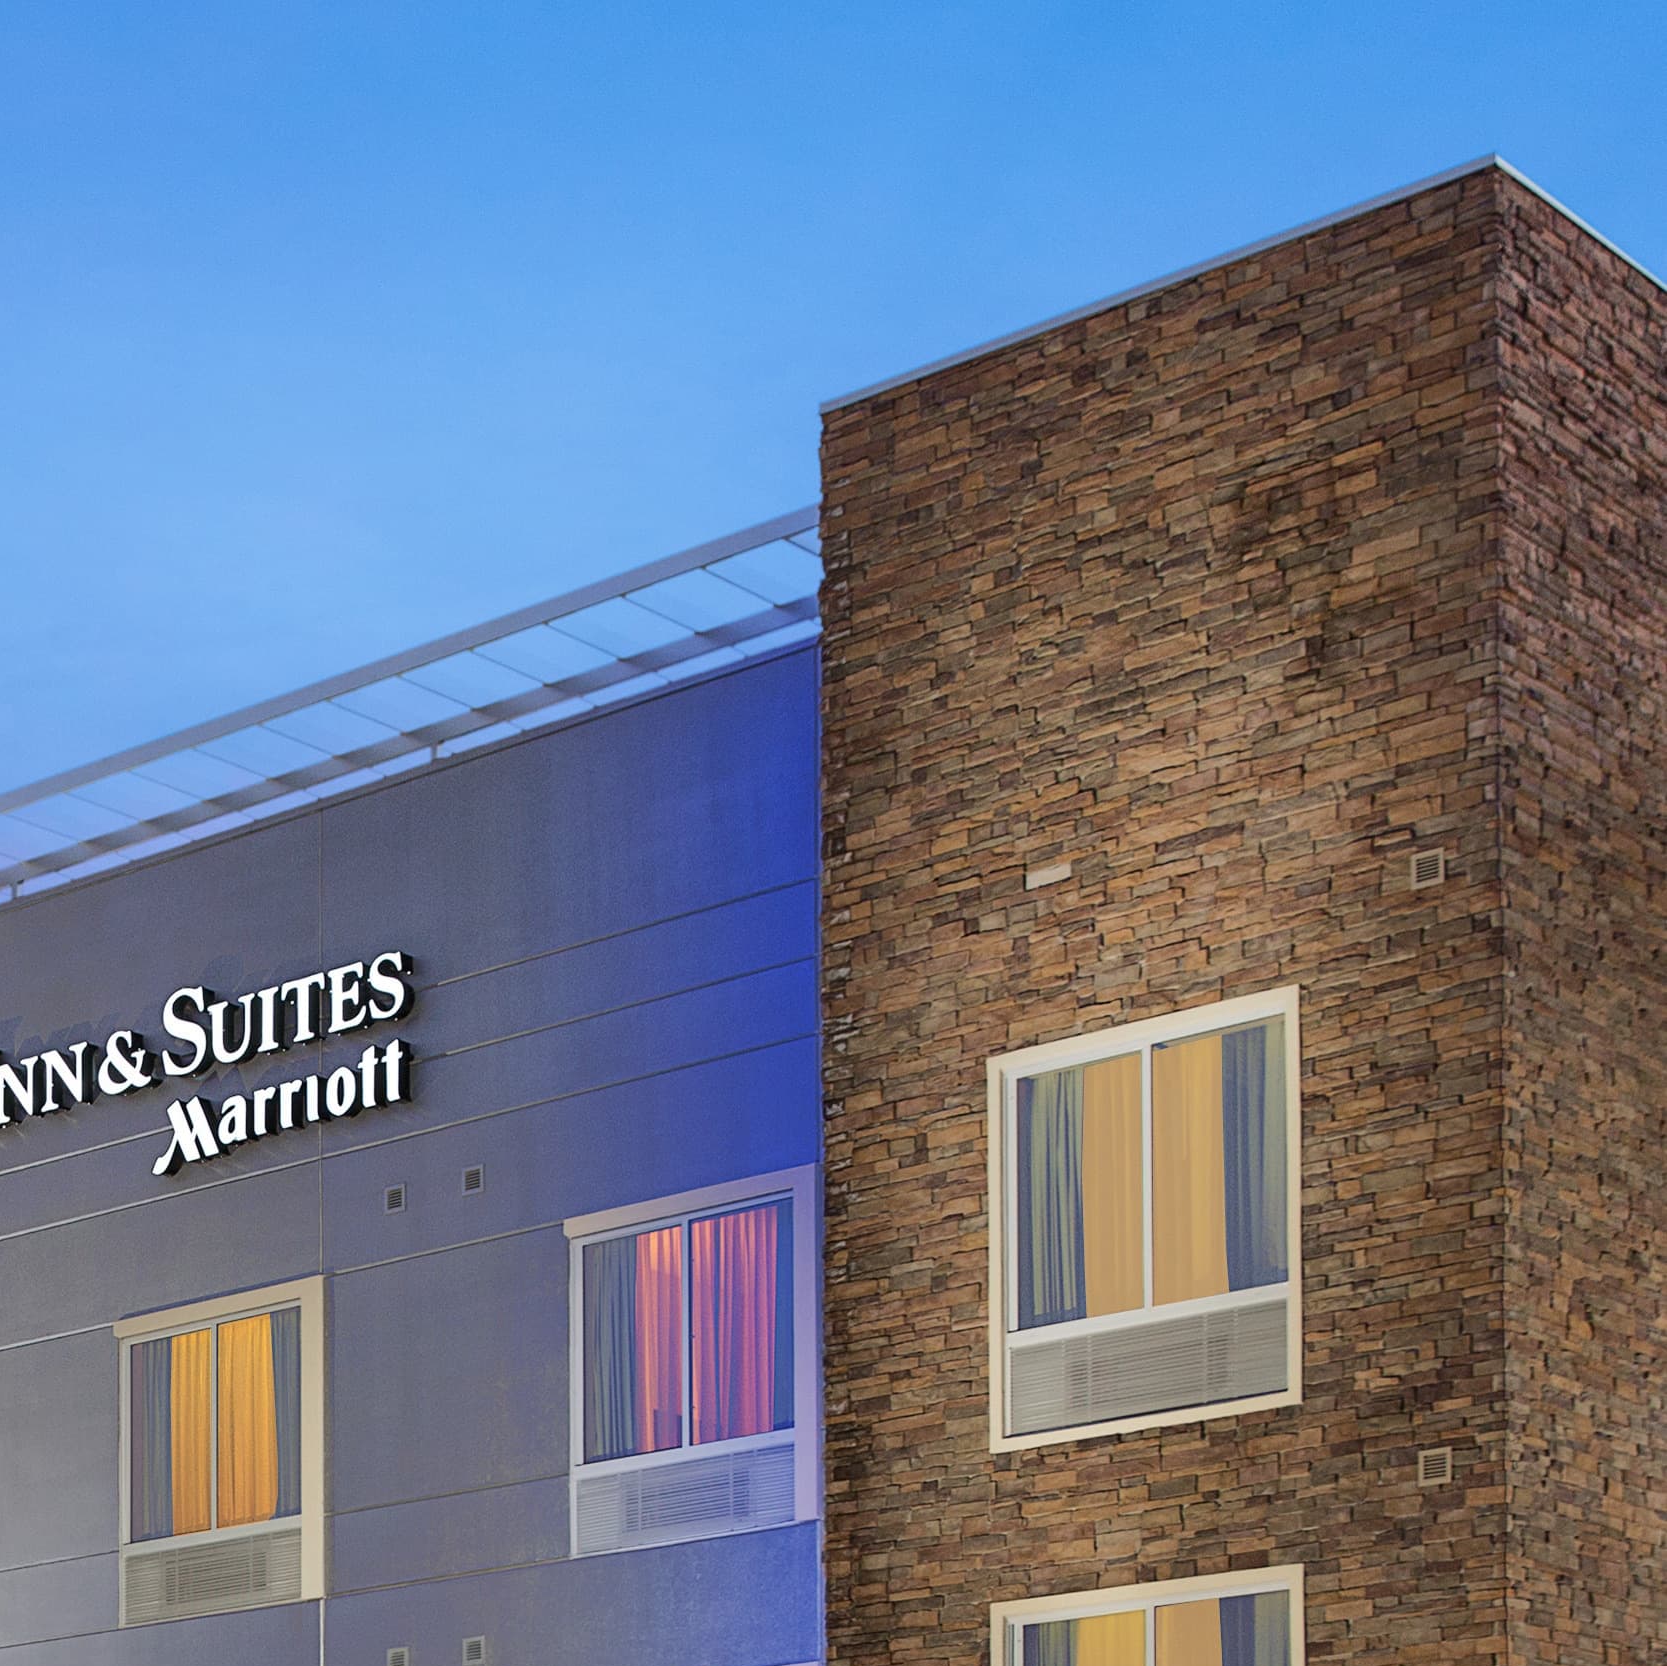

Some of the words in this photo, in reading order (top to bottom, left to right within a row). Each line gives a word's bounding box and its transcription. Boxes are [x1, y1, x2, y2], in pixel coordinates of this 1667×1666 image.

[98, 1029, 153, 1096] &
[161, 950, 407, 1076] SUITES
[152, 1038, 407, 1176] Marriott
